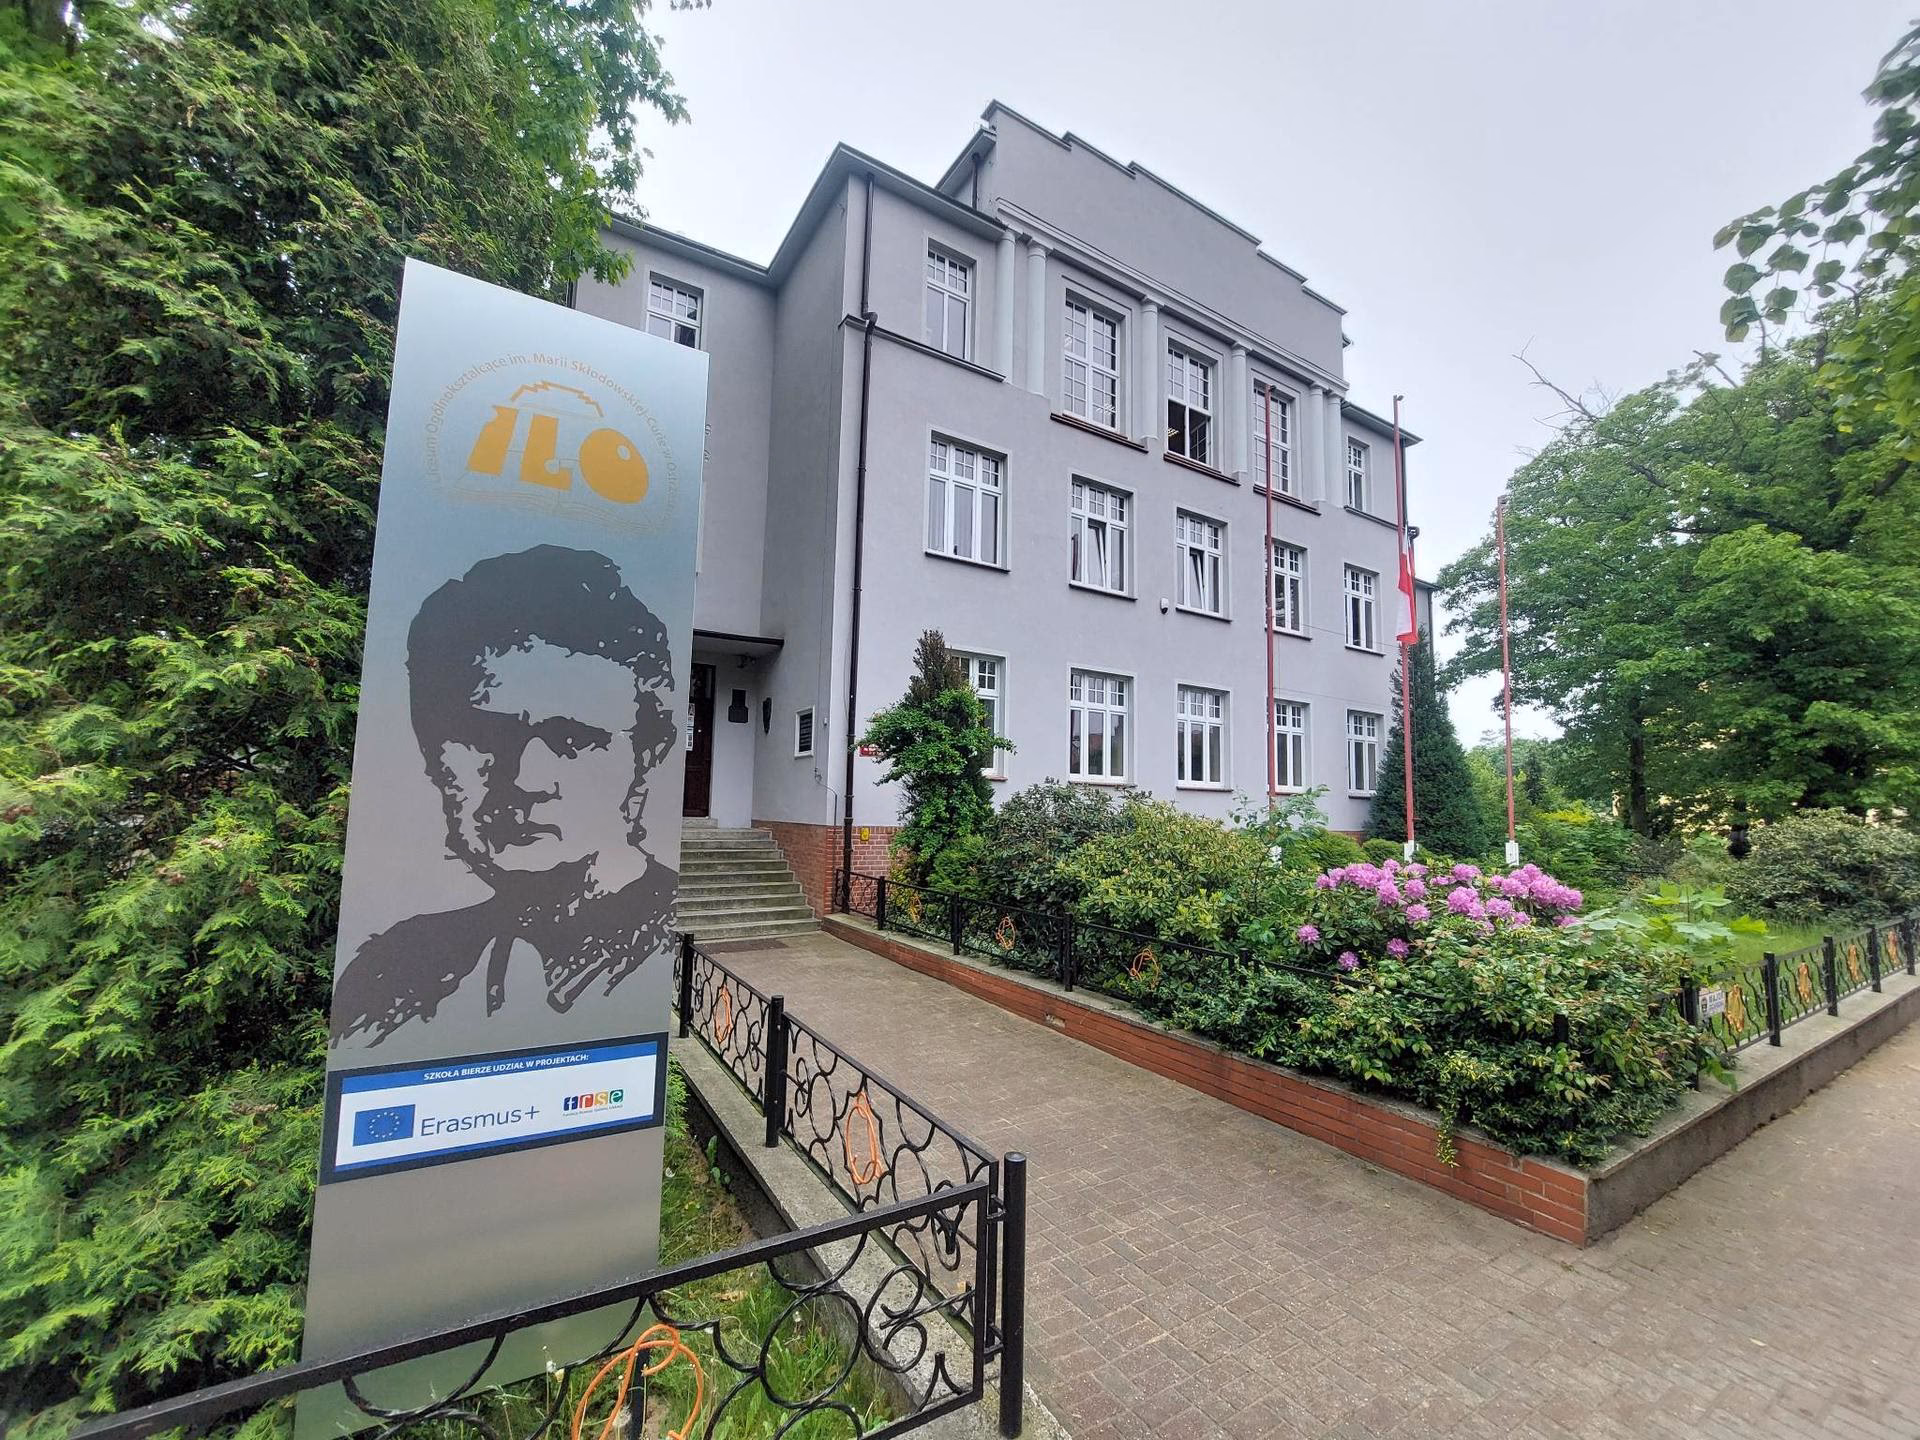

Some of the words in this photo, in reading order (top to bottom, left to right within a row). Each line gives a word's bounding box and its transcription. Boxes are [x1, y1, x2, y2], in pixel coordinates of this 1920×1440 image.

[533, 353, 567, 367] Marii
[423, 1069, 459, 1081] SZKOŁA
[461, 1065, 491, 1076] BIERZE
[492, 1061, 524, 1072] UDZIAŁ
[526, 1060, 535, 1068] W
[535, 1054, 589, 1067] PROJEKTACH:
[421, 1106, 540, 1137] Erasmus+
